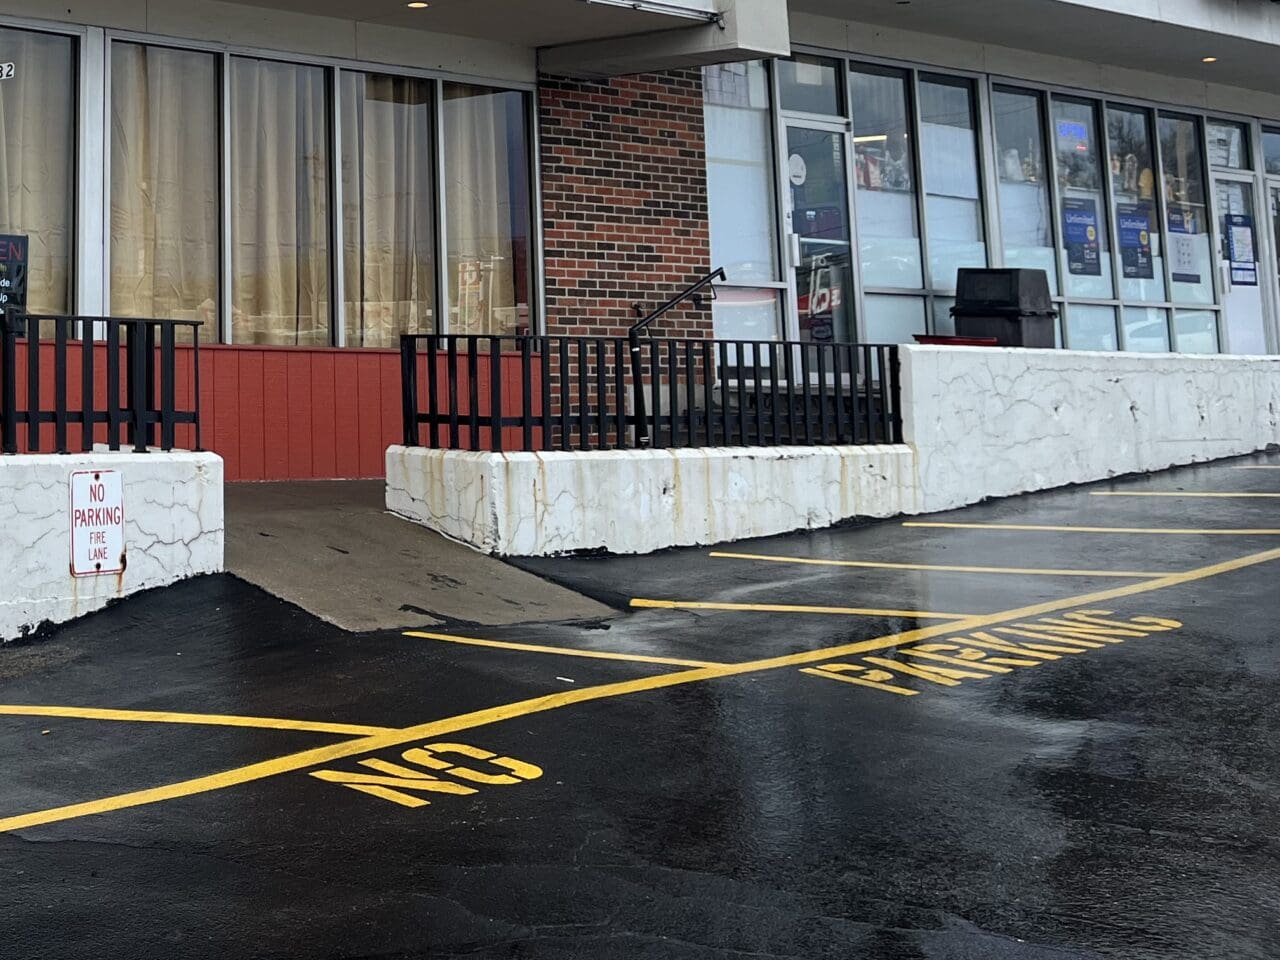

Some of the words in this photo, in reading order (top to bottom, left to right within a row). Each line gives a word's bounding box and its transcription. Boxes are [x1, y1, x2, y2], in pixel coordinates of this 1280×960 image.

[89, 483, 105, 503] NO
[74, 506, 121, 528] PARKING
[89, 531, 106, 545] FIRE
[88, 547, 108, 561] LANE
[308, 742, 544, 808] NO
[798, 609, 1183, 696] PARKING
